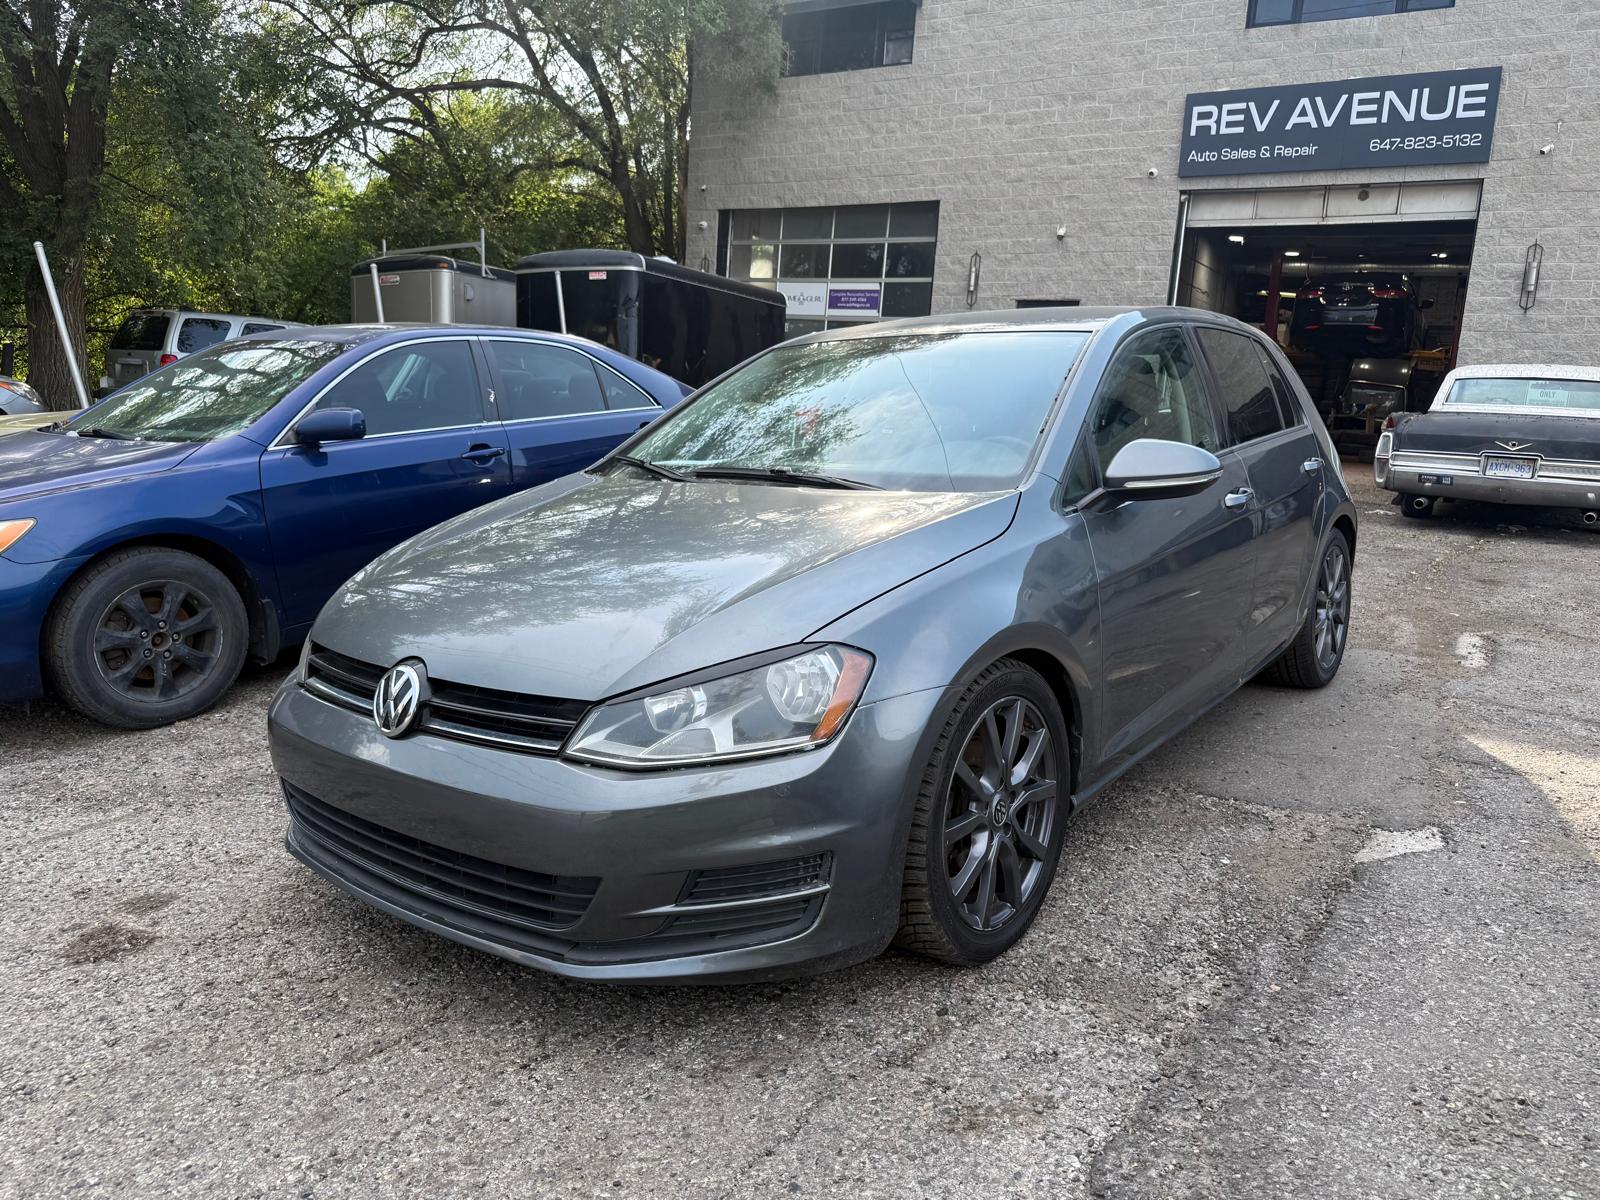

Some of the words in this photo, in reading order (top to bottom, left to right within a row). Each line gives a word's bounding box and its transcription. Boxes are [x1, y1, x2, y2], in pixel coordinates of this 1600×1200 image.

[1190, 100, 1280, 136] REV
[1284, 83, 1489, 130] AVENUE
[1369, 133, 1482, 151] 647-823-5132
[1187, 150, 1217, 162] Auto
[1221, 148, 1256, 160] Sales
[1260, 146, 1270, 158] &
[1274, 144, 1318, 158] Repair
[1540, 390, 1557, 399] ONLY
